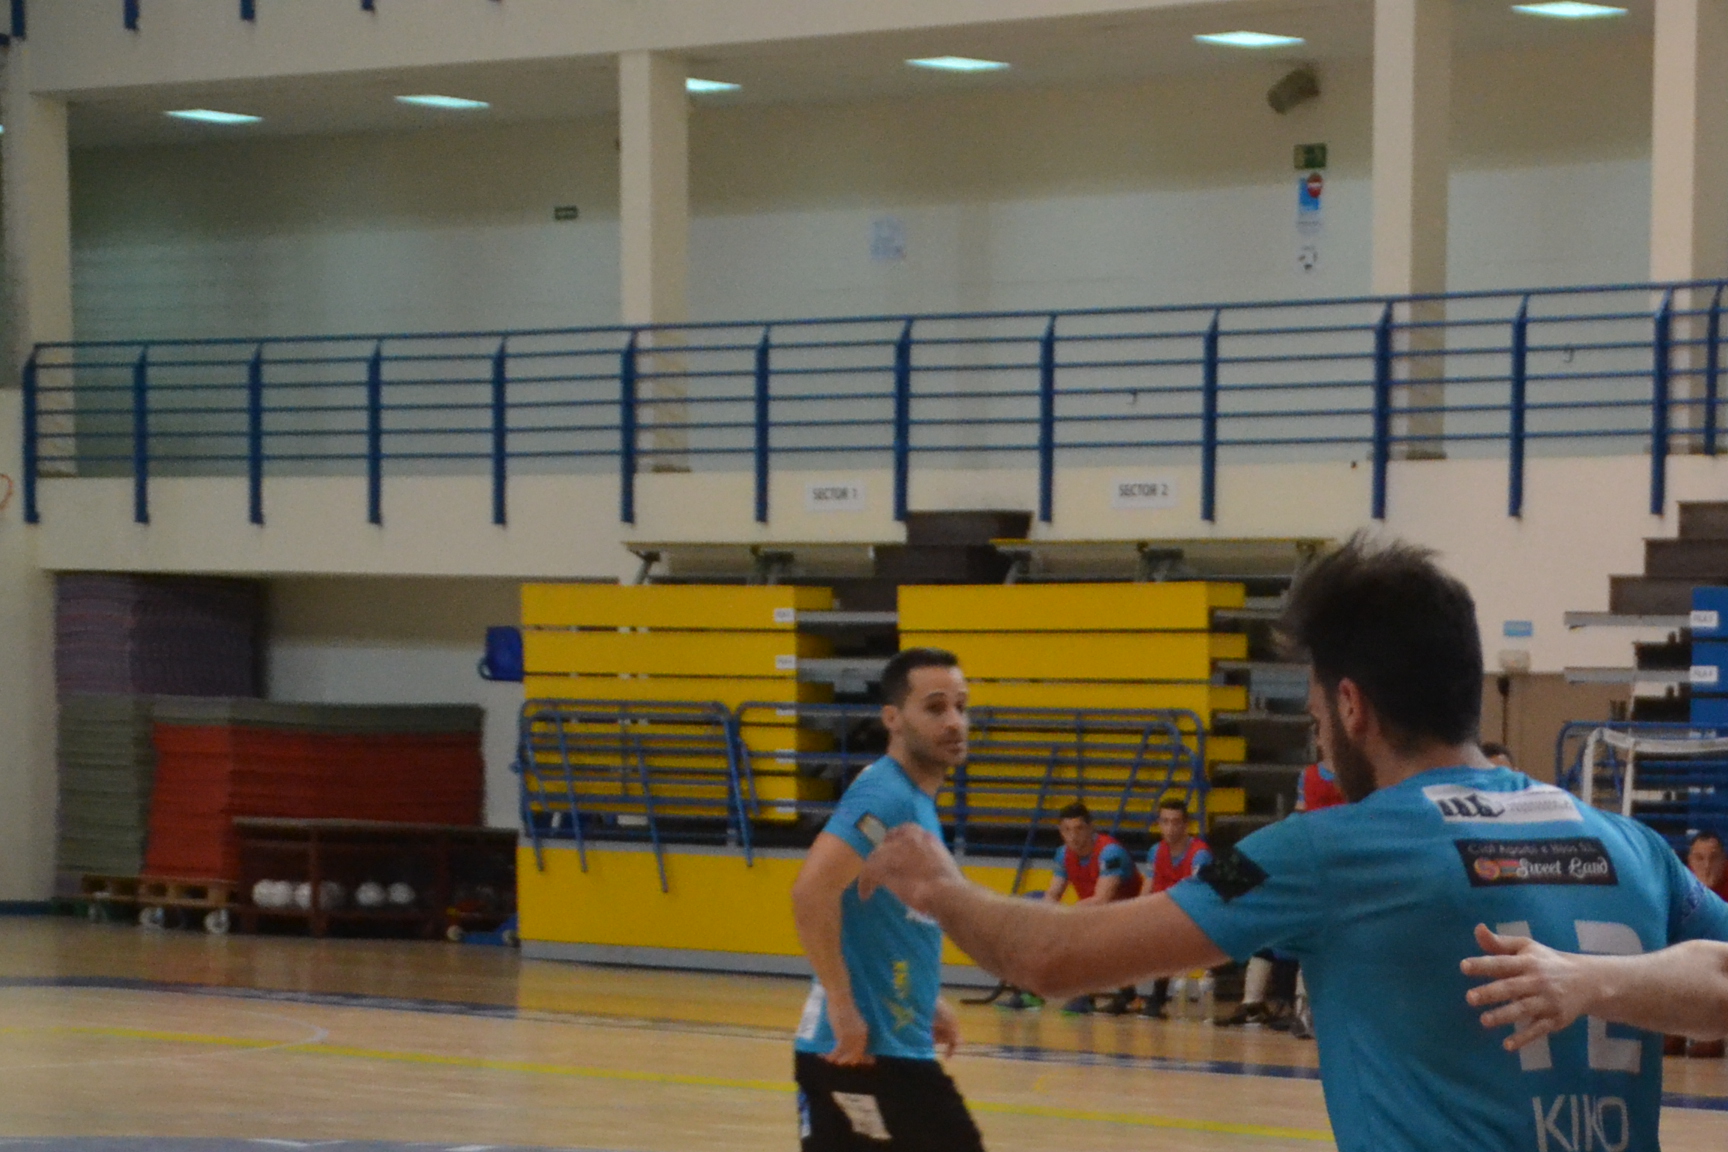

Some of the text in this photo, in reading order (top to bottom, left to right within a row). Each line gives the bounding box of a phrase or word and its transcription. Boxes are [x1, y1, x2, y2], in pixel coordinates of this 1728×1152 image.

[813, 487, 848, 500] SECTOR
[1119, 483, 1168, 496] SECTOR 2
[1515, 856, 1609, 880] Sweet Land
